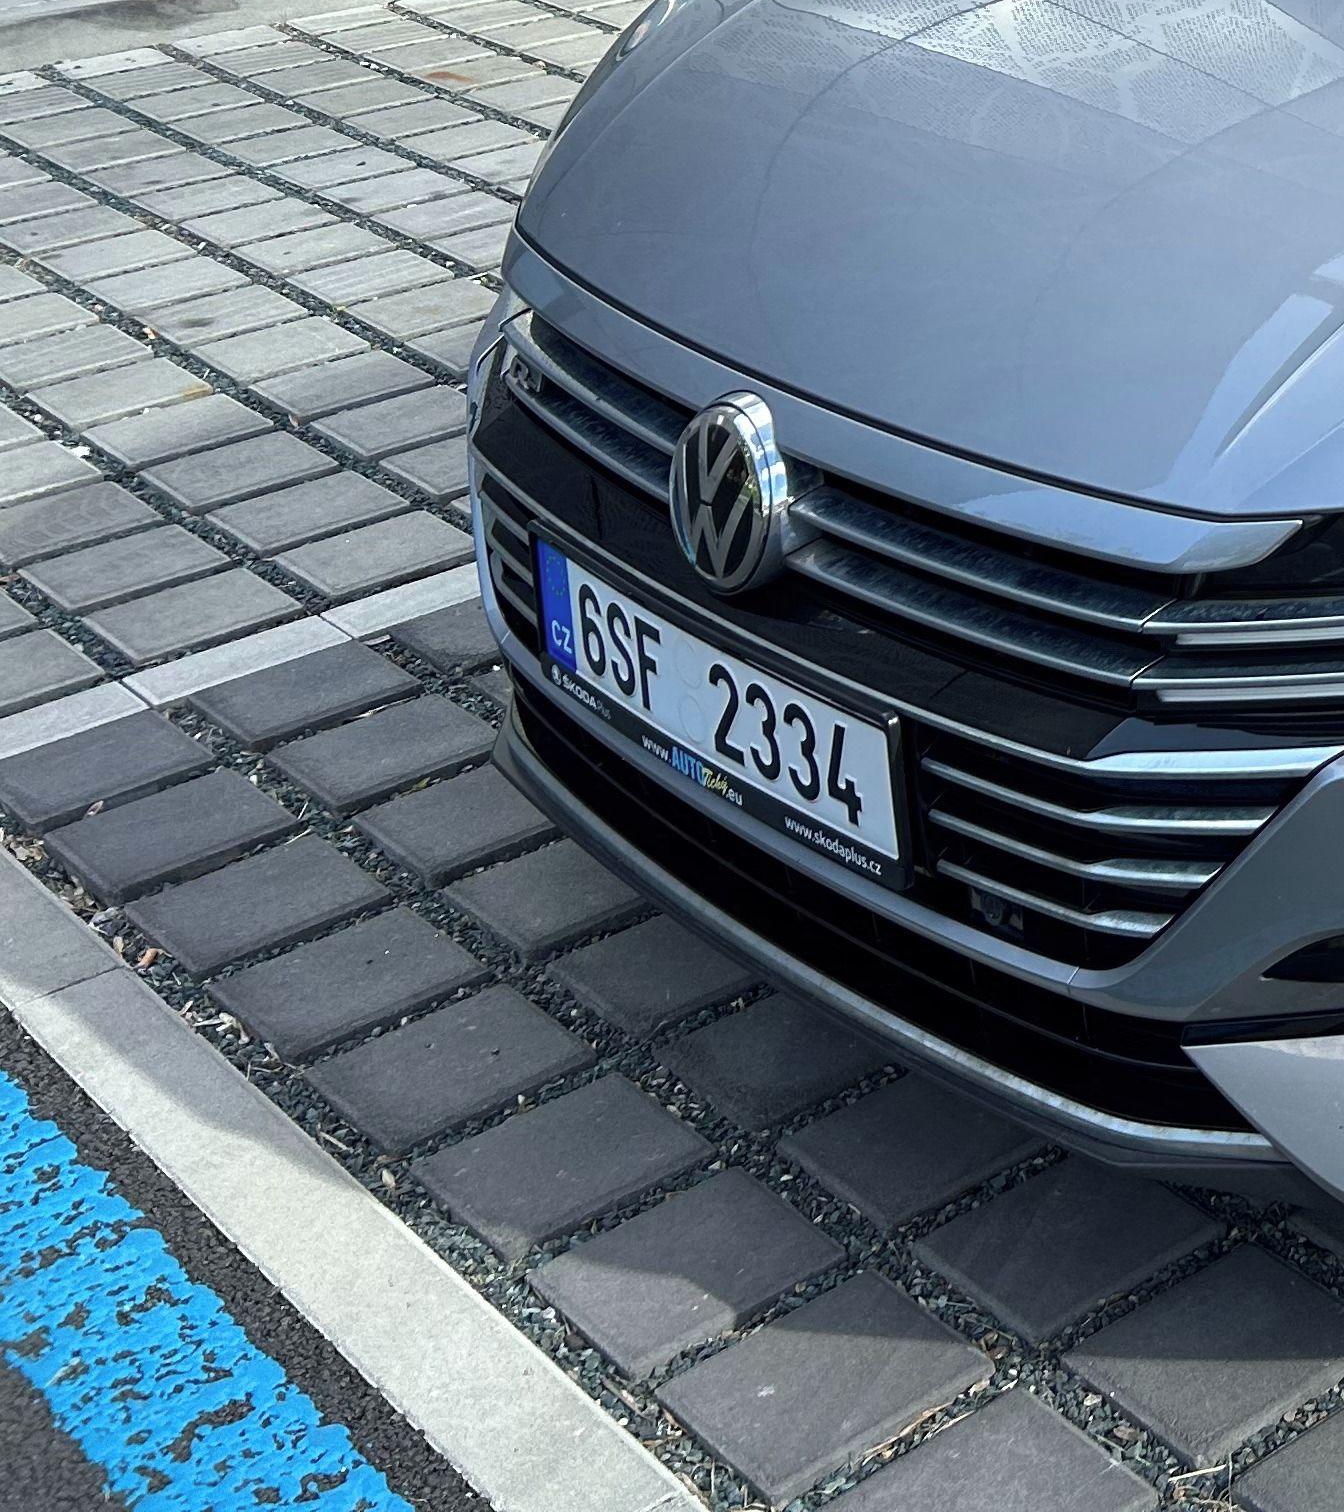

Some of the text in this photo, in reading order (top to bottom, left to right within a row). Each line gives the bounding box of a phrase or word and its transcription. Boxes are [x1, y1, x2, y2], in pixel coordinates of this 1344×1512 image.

[552, 619, 573, 655] CZ
[579, 583, 862, 826] 6SF 2334
[784, 815, 882, 876] www.skodaplus.cz
